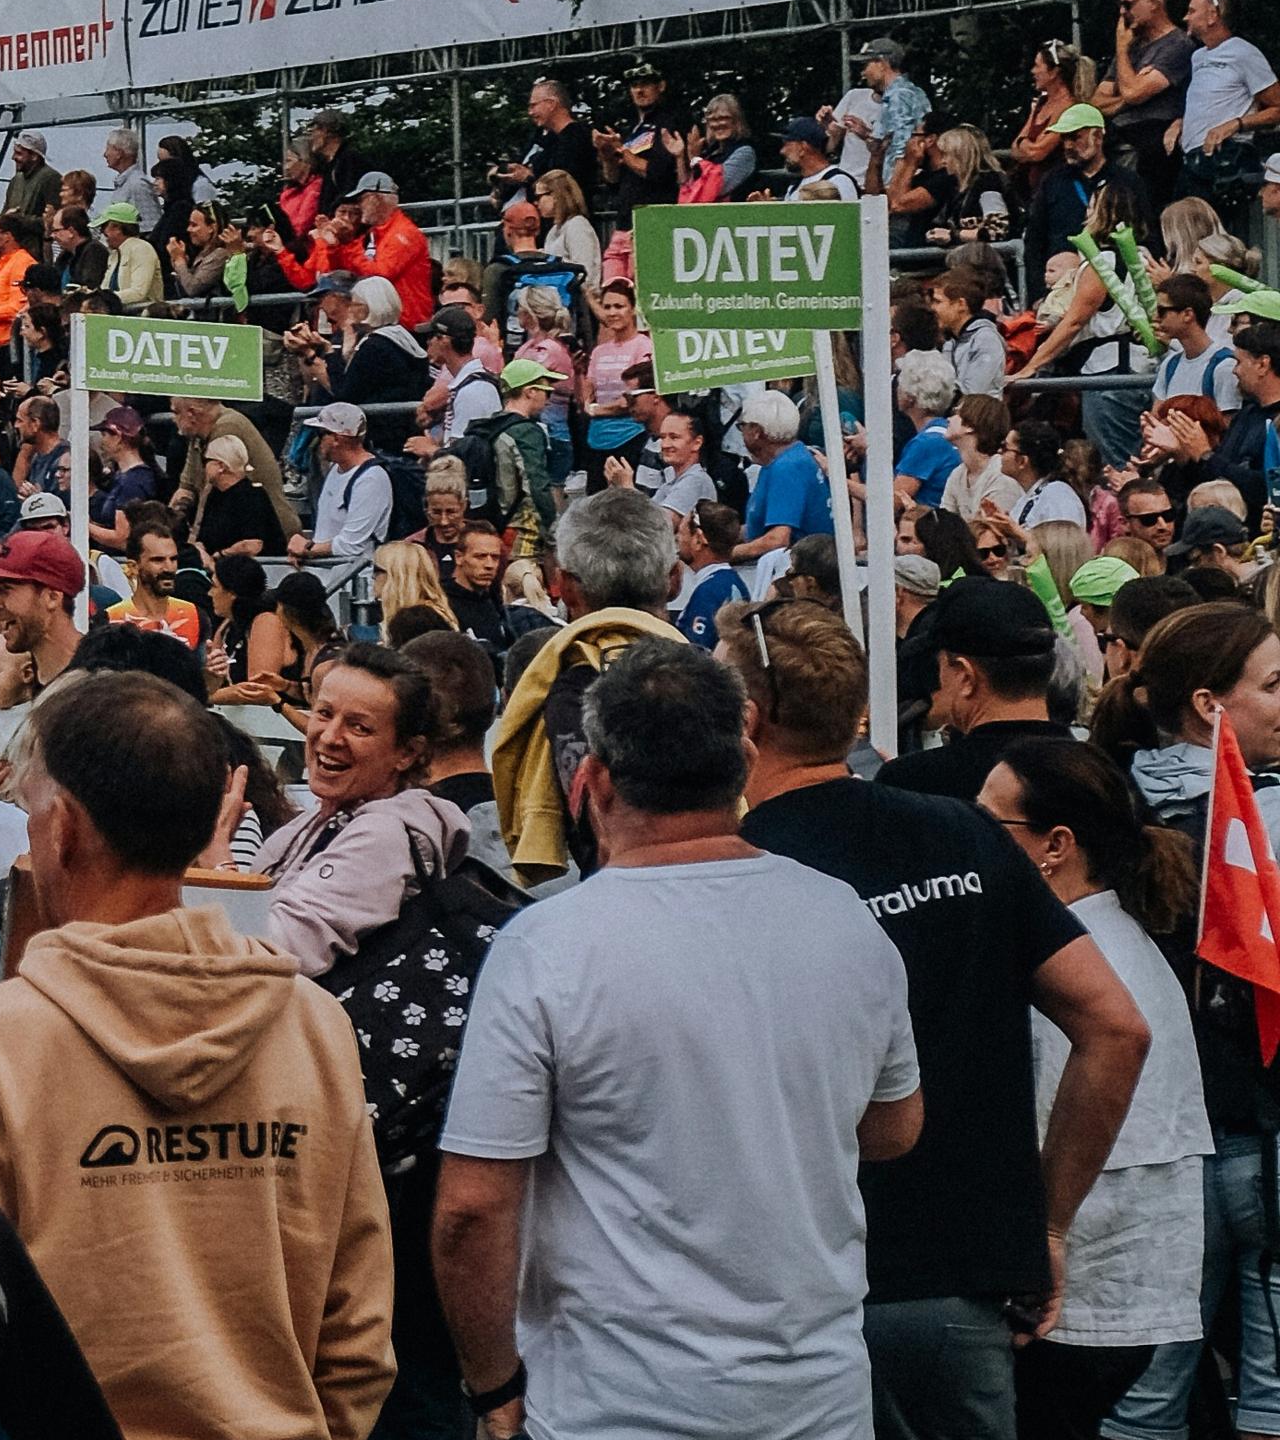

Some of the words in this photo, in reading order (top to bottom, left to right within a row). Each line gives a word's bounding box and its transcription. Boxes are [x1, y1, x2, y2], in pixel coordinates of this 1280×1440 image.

[672, 224, 836, 283] DATEV
[650, 292, 704, 311] Zukunft
[706, 292, 775, 314] gestalten.
[107, 328, 230, 370] DATEV
[677, 328, 788, 365] DATEV
[146, 1121, 305, 1164] RESTUBE
[80, 1173, 117, 1188] MEHR
